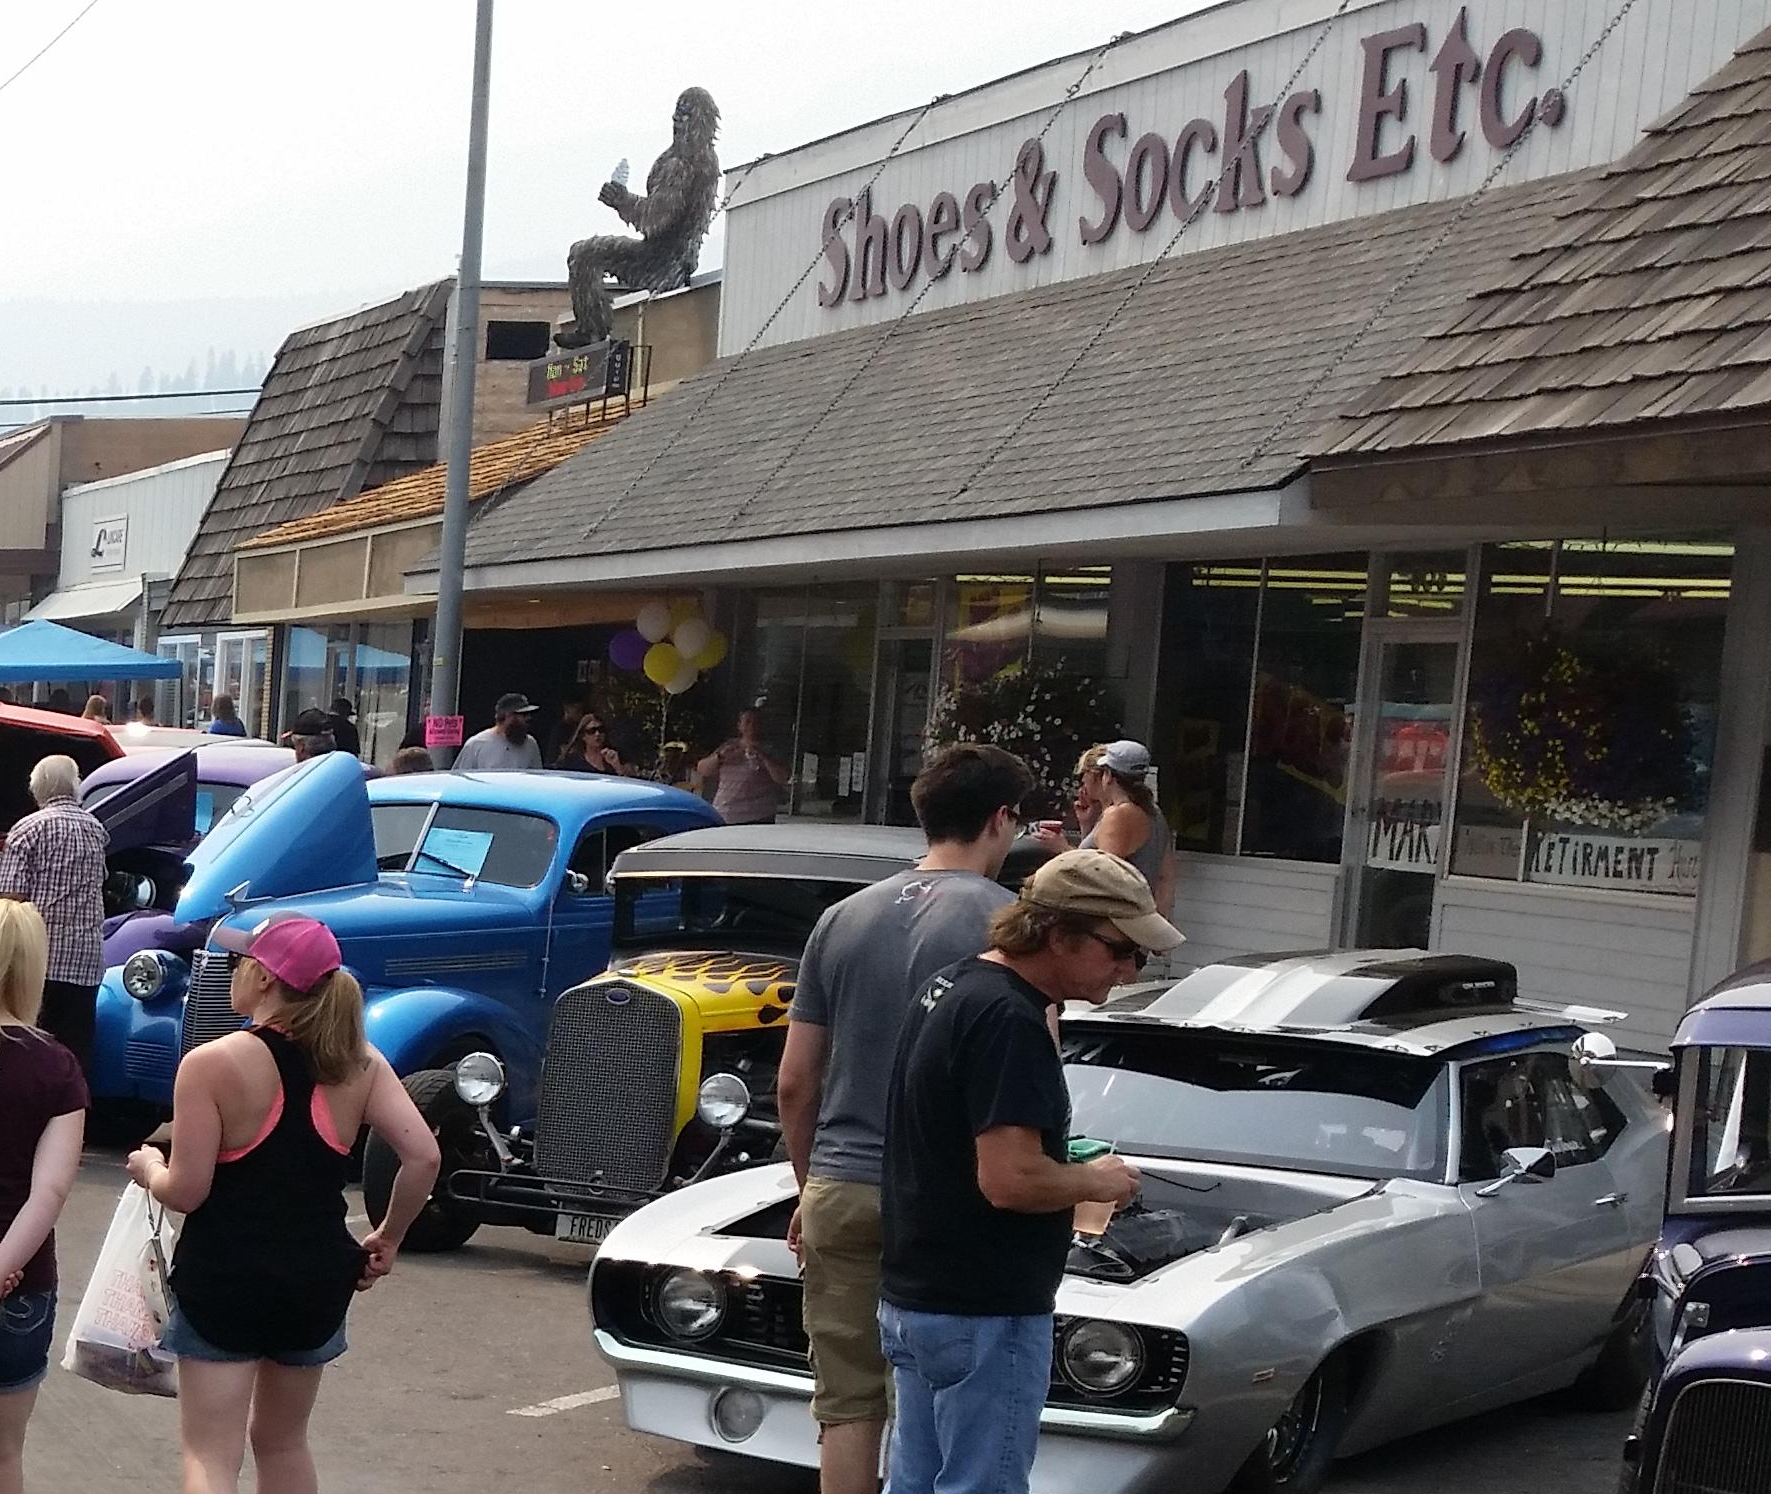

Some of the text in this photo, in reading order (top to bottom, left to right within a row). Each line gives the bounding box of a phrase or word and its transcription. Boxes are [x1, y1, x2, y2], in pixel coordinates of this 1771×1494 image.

[818, 5, 1565, 307] Shoes & Socks Etc.
